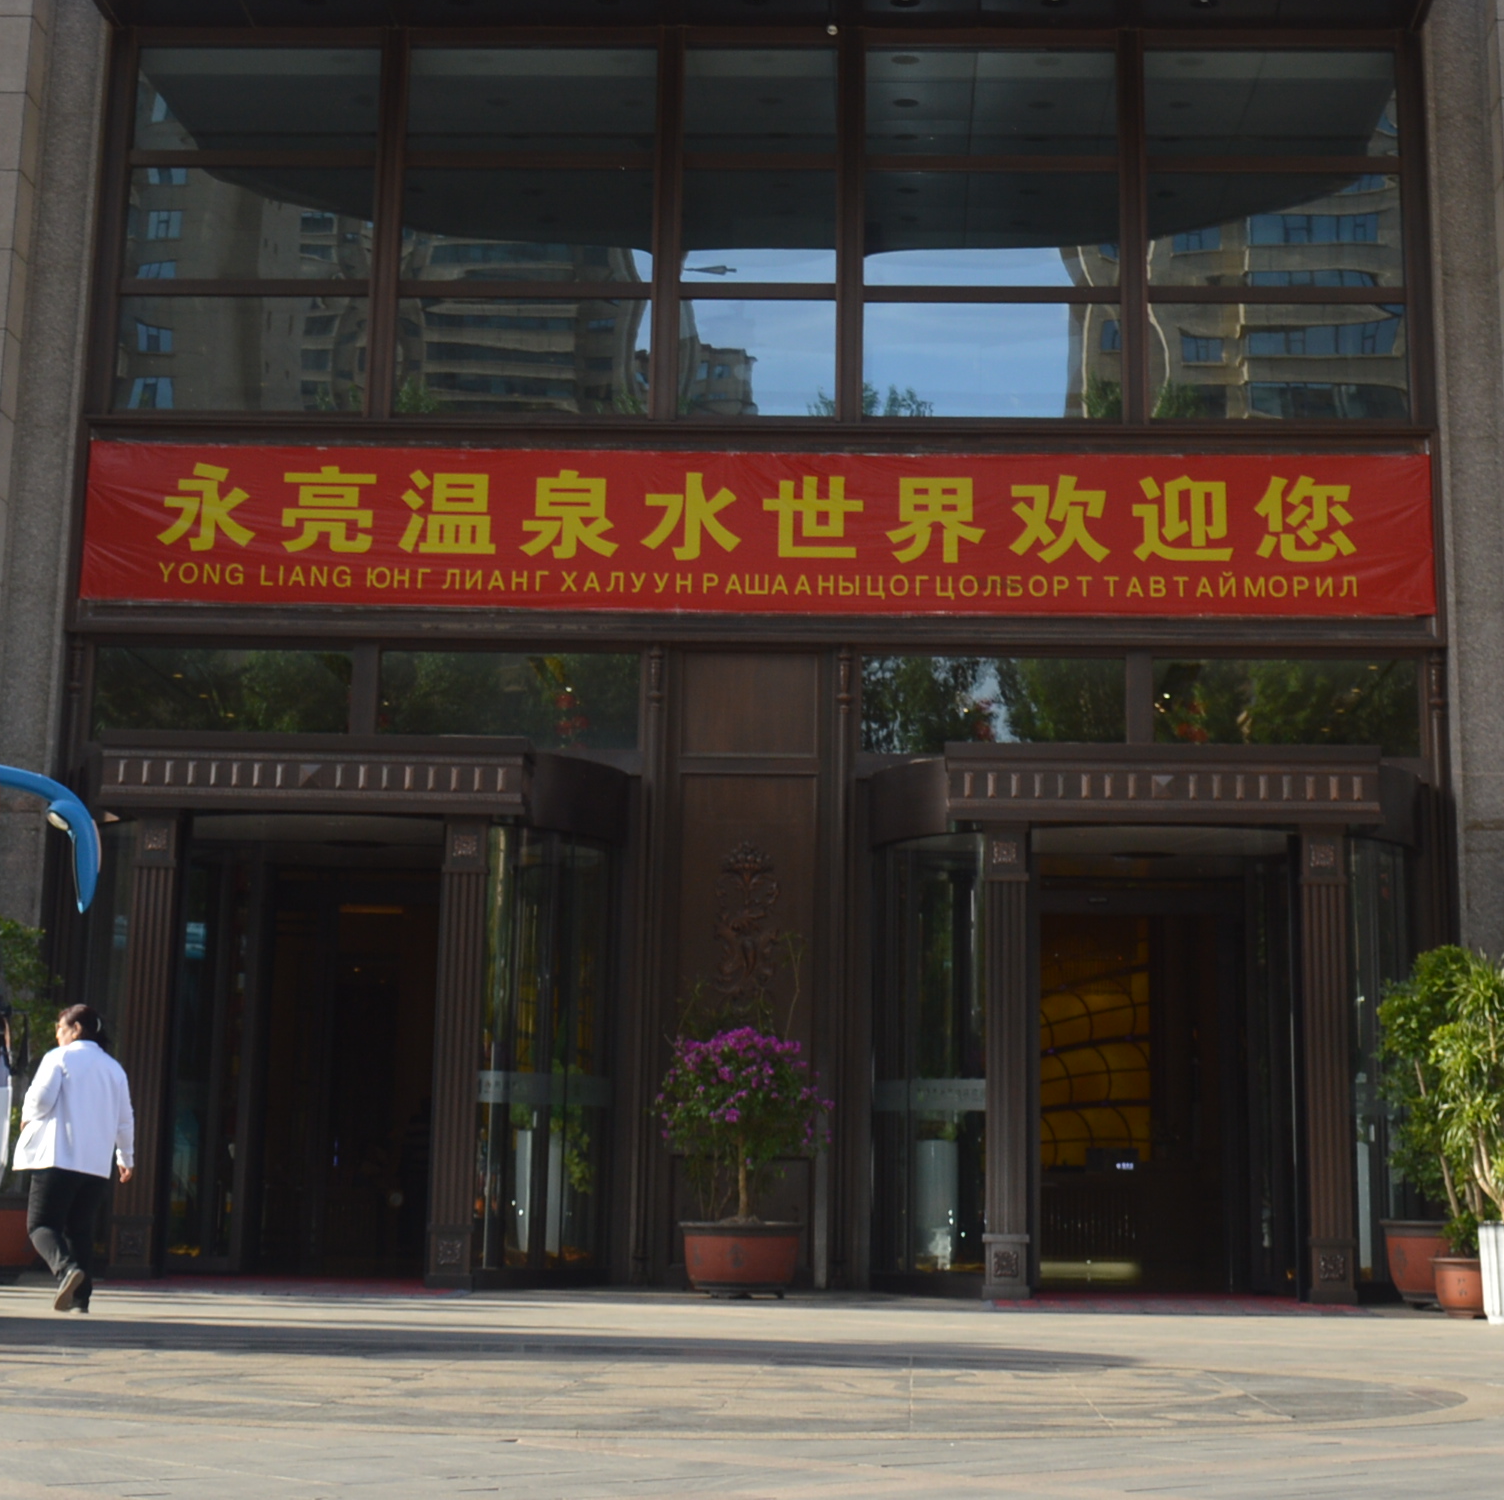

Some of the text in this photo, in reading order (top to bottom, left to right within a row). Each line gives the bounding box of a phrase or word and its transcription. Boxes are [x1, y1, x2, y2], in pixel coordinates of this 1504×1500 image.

[156, 461, 1358, 564] 永亮温泉水世界欢迎您
[158, 561, 245, 586] YONG
[259, 564, 352, 588] LIANG
[366, 566, 432, 589] ЮНГ
[441, 568, 550, 592] ЛИАНГ
